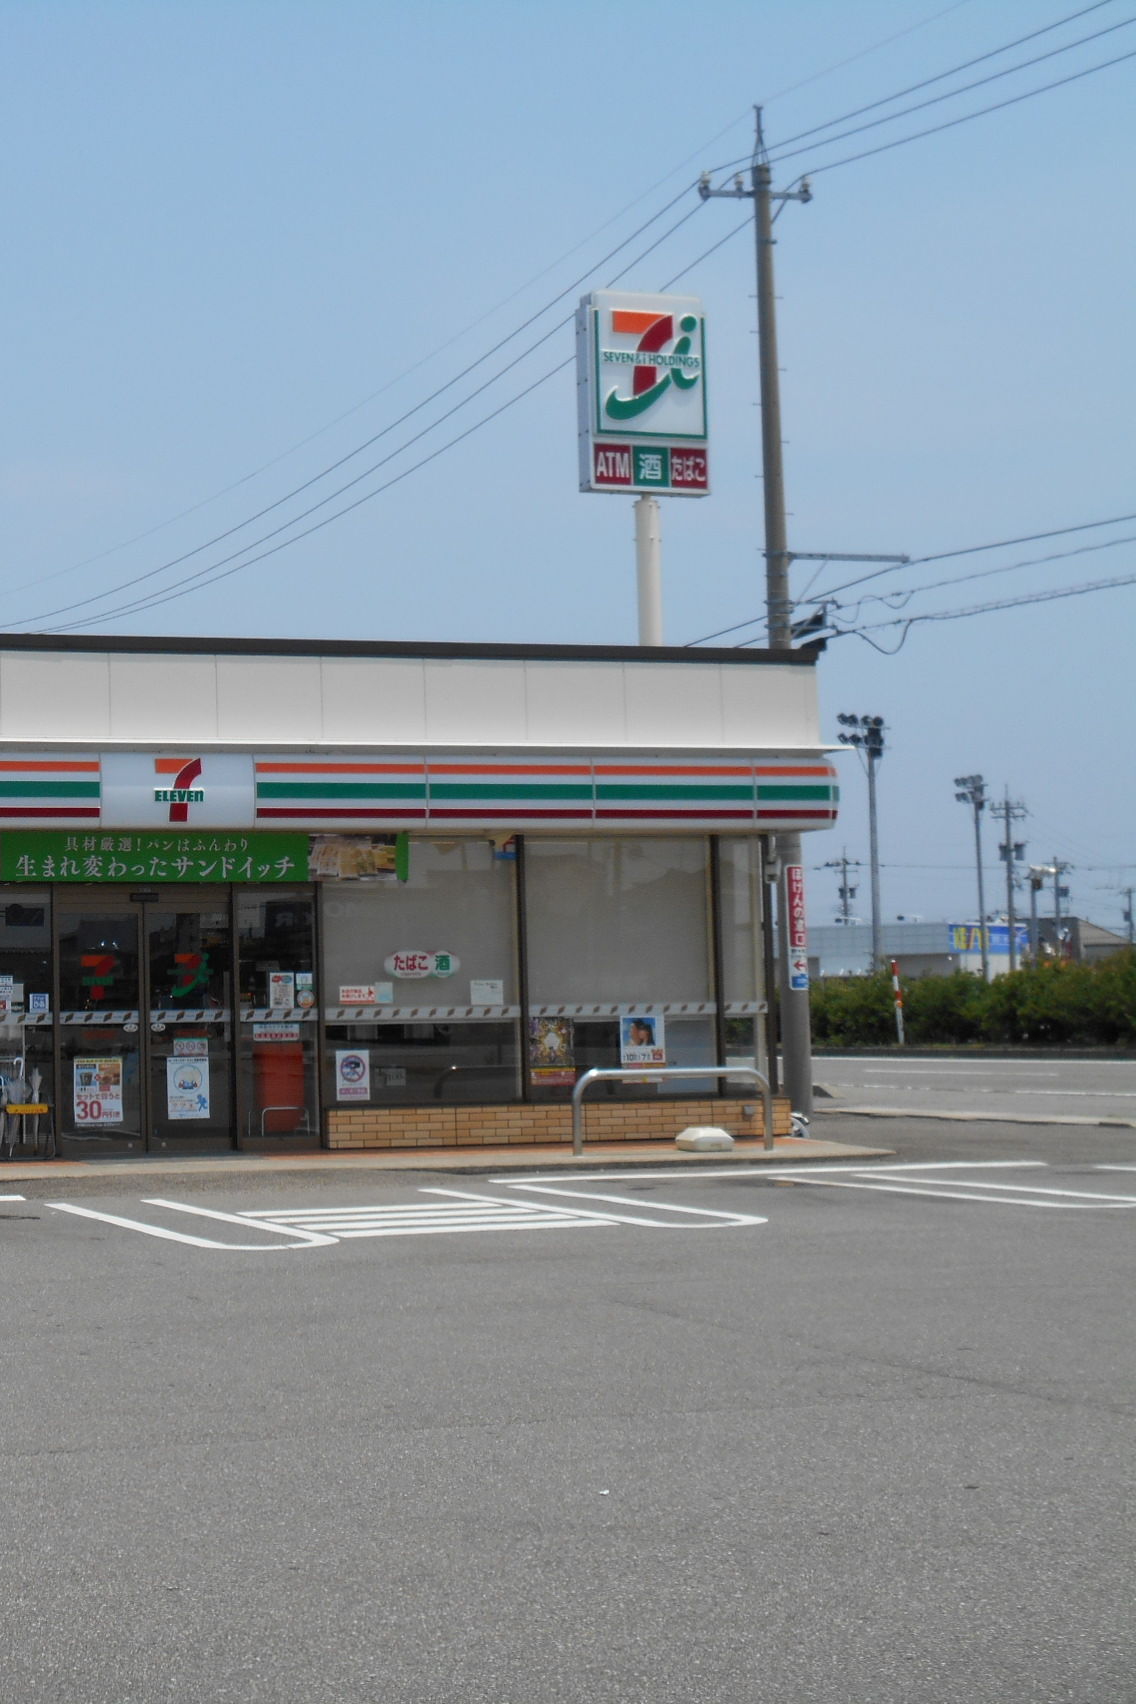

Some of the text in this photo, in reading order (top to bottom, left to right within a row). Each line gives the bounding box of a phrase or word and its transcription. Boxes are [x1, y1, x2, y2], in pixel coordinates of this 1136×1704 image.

[648, 353, 700, 368] HOLDINGS
[596, 452, 630, 478] ATM
[639, 453, 662, 480] 酒
[671, 455, 706, 482] たばこ
[15, 854, 295, 879] 生まれ変わったサンドイッチ
[393, 954, 451, 971] たばこ 酒
